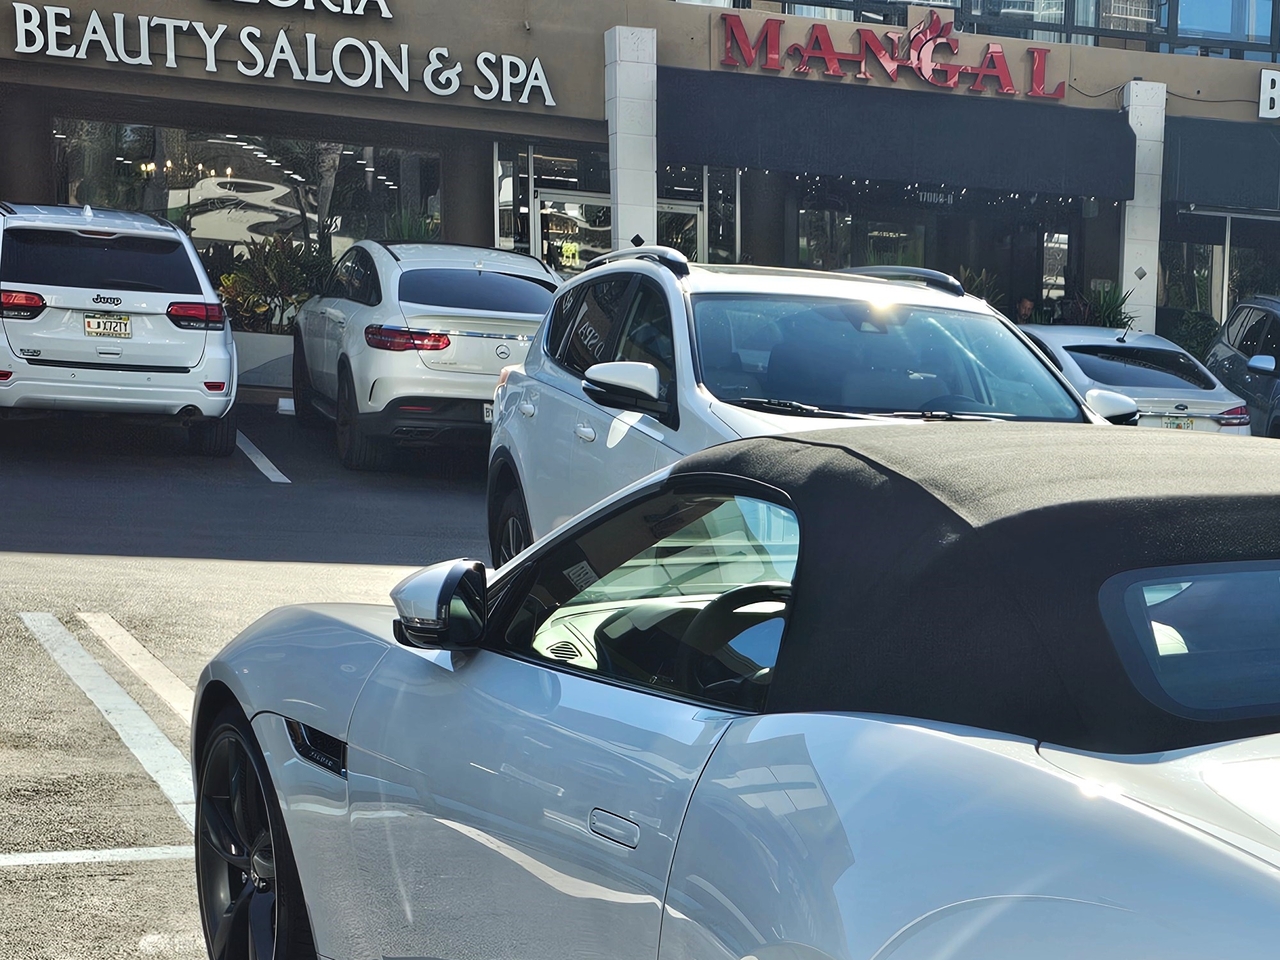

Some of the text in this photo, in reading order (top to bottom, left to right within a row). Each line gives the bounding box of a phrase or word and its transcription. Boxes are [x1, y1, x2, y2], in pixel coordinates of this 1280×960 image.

[12, 2, 557, 106] BEAUTY SALON & SPA
[720, 12, 1066, 99] MANGAL
[92, 293, 122, 307] Jeep
